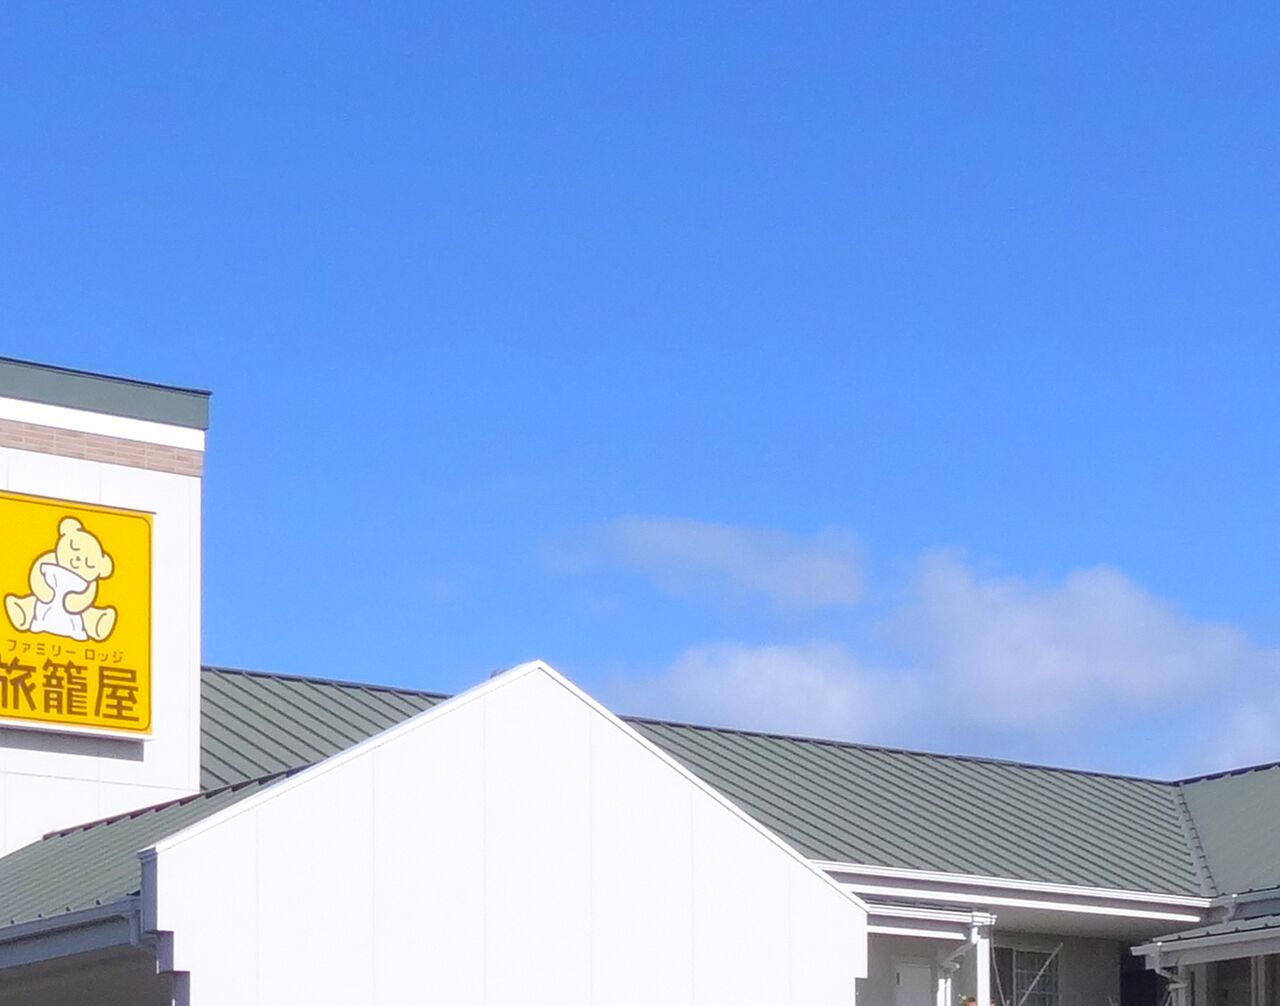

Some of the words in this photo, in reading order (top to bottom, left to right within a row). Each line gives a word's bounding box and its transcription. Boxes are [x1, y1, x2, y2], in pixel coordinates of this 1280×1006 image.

[7, 639, 76, 657] ファミリー
[84, 648, 123, 663] ロッジ
